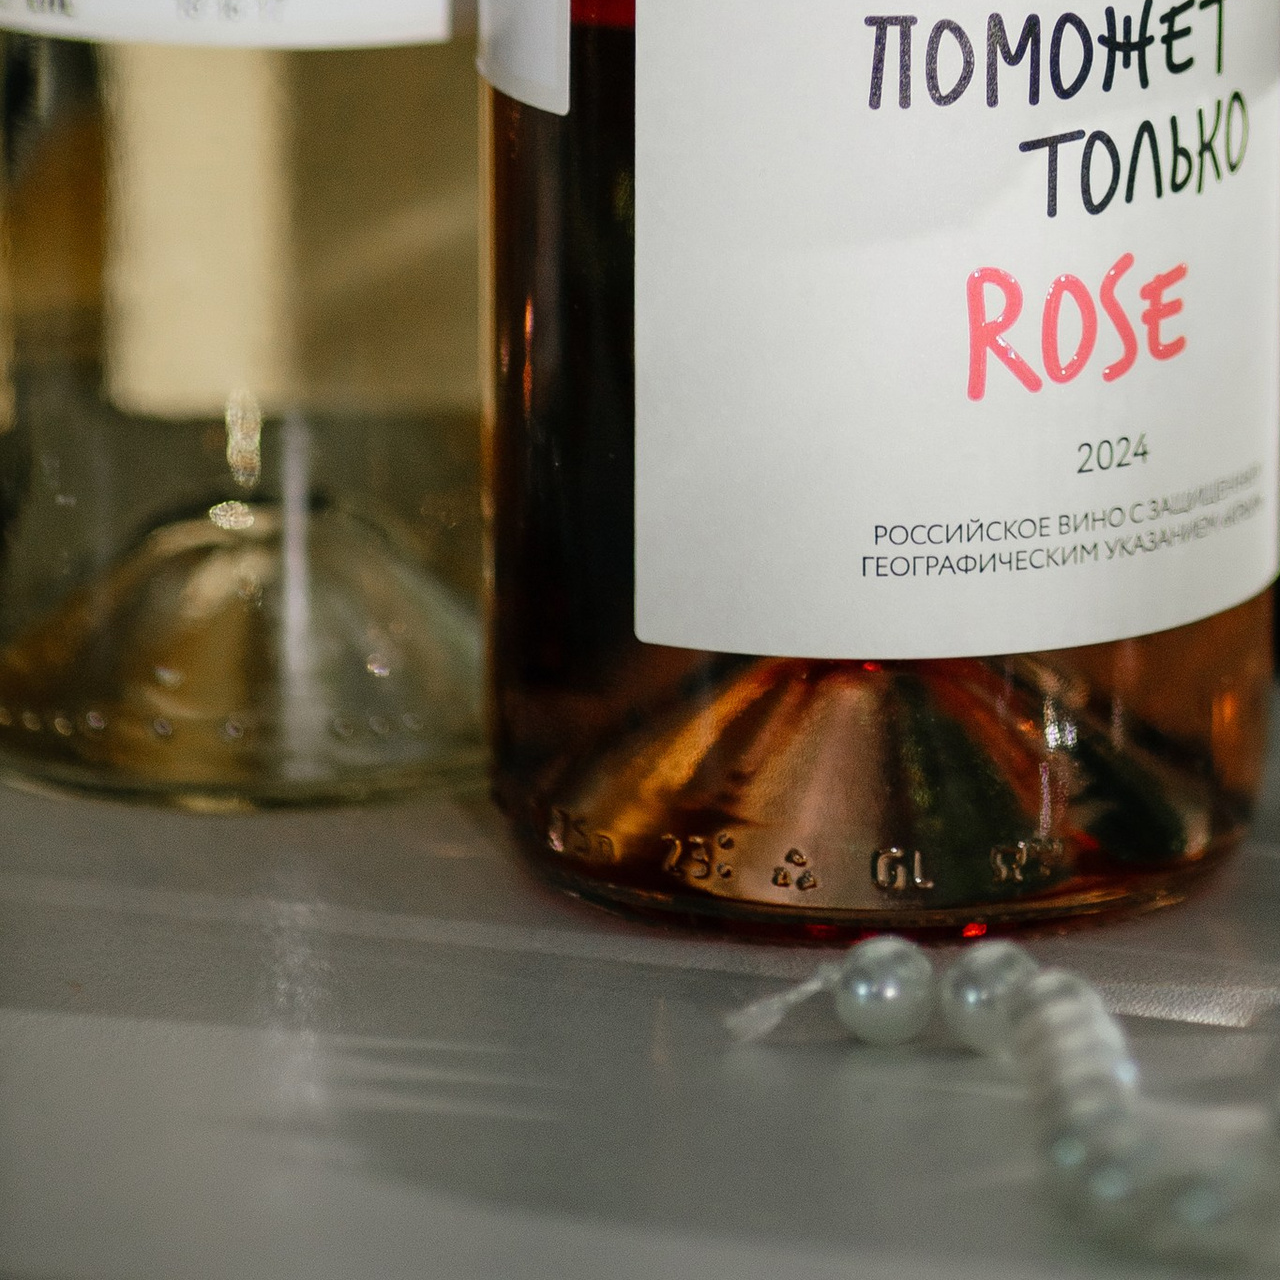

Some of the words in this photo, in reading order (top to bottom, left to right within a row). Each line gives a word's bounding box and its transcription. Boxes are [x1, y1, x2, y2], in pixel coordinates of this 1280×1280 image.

[1018, 90, 1251, 219] ТОЛЬКО
[965, 251, 1190, 403] ROSE
[1076, 435, 1151, 475] 2024
[874, 515, 1052, 546] РОССИЙСКОЕ
[1058, 506, 1127, 536] ВИНО
[1129, 502, 1145, 525] С
[862, 542, 1100, 578] ГЕОГРАФИЧЕСКИМ
